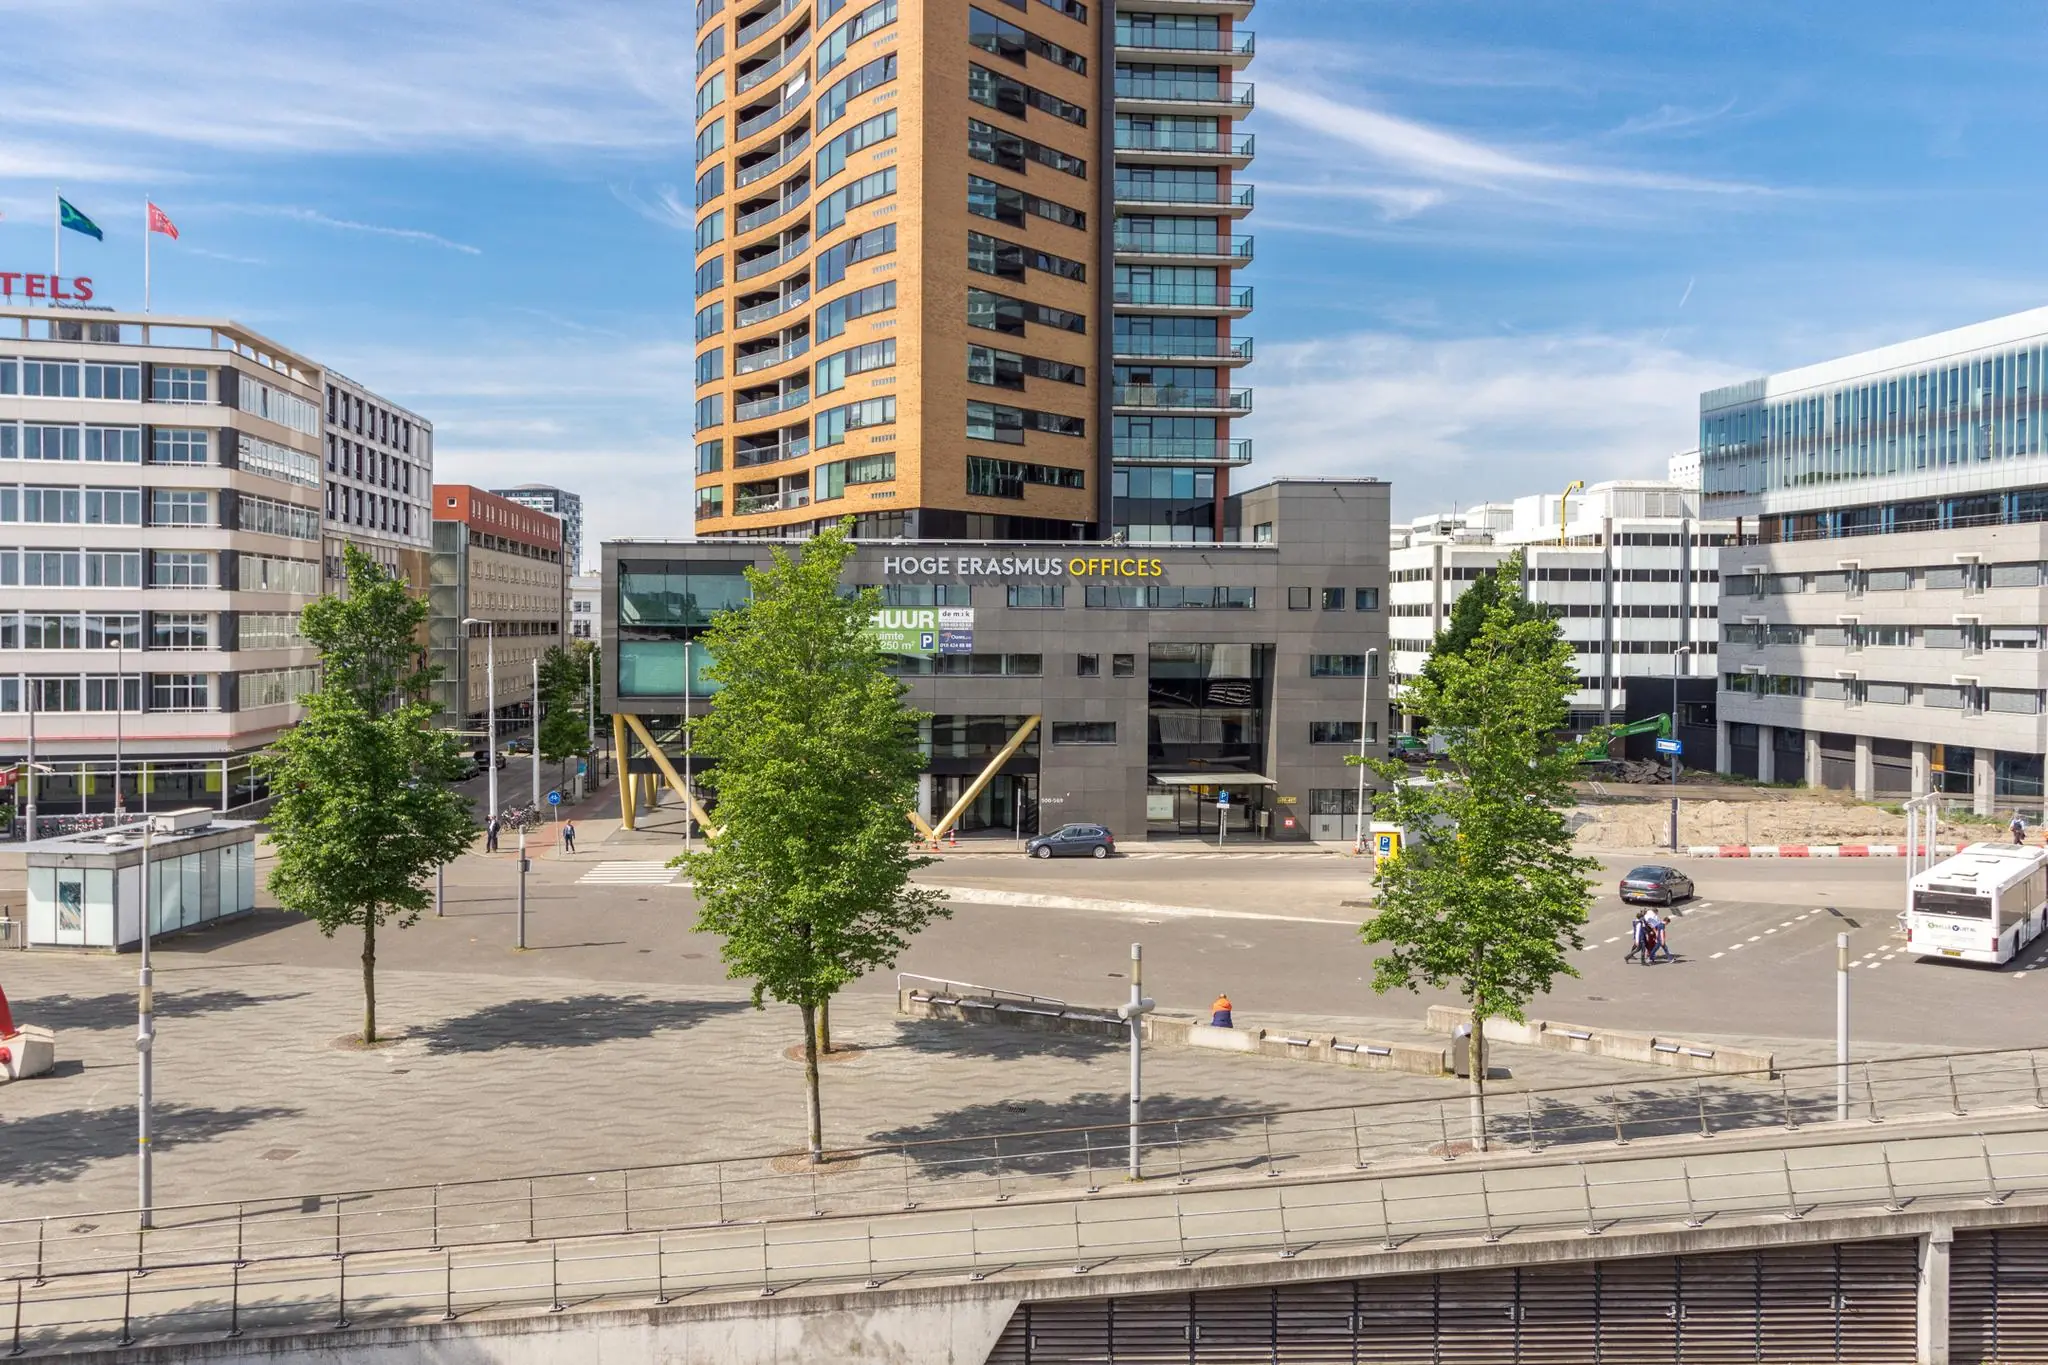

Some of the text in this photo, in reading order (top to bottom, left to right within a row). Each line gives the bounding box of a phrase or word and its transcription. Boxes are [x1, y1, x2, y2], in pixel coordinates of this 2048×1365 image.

[883, 556, 1162, 577] HOGE ERASMUS OFFICES
[922, 635, 933, 648] P
